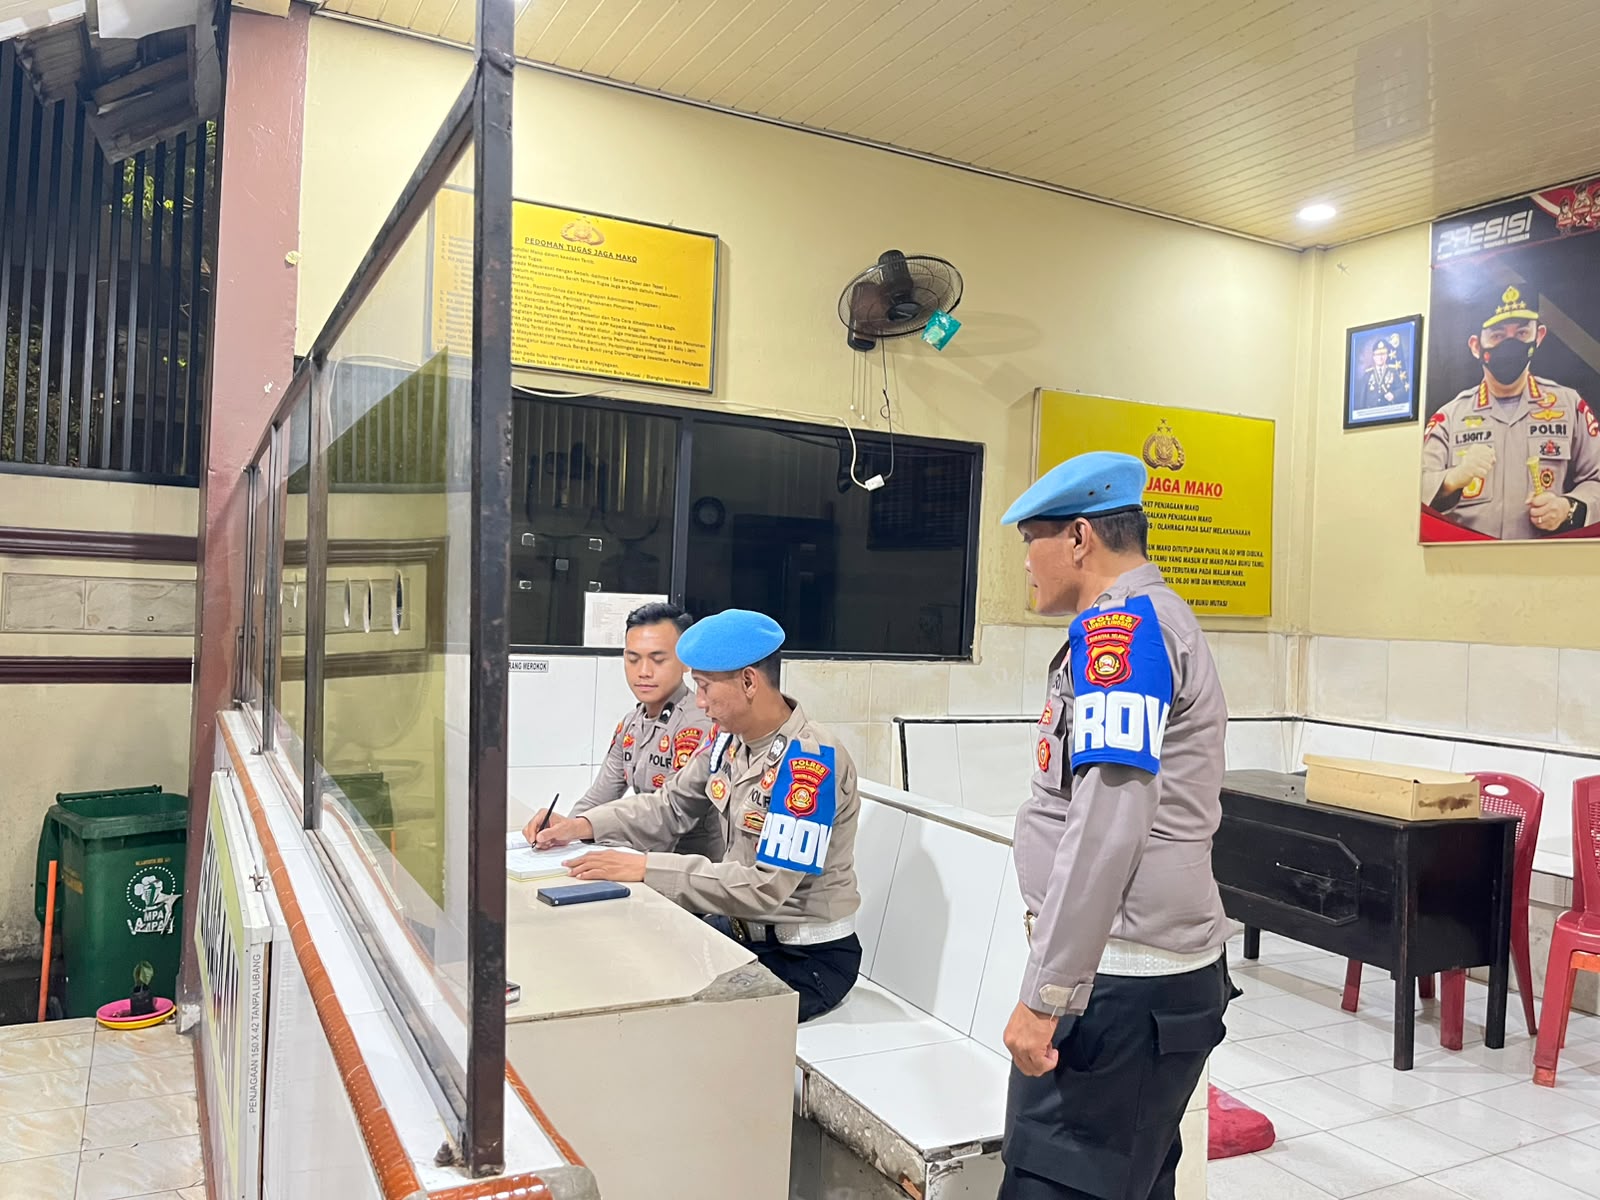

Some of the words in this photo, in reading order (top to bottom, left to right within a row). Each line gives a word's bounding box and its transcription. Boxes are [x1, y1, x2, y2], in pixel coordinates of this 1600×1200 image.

[1438, 210, 1533, 252] PRESISI
[525, 236, 564, 250] PEDOMAN
[567, 243, 592, 255] TUGAS
[594, 248, 614, 258] JAGA
[616, 252, 638, 262] MAKO
[1530, 424, 1566, 435] POLRI
[1147, 477, 1180, 493] JAGA
[1184, 480, 1223, 497] MAKO
[1089, 614, 1133, 625] POLRES
[523, 663, 547, 671] MEROKOK
[1074, 691, 1170, 760] ROV
[792, 760, 826, 775] POLRES
[252, 954, 261, 991] LUBANG
[252, 992, 261, 1020] TANPA
[251, 1022, 260, 1033] 42
[251, 1042, 259, 1057] 150
[249, 1060, 259, 1114] PENJAGAAN
